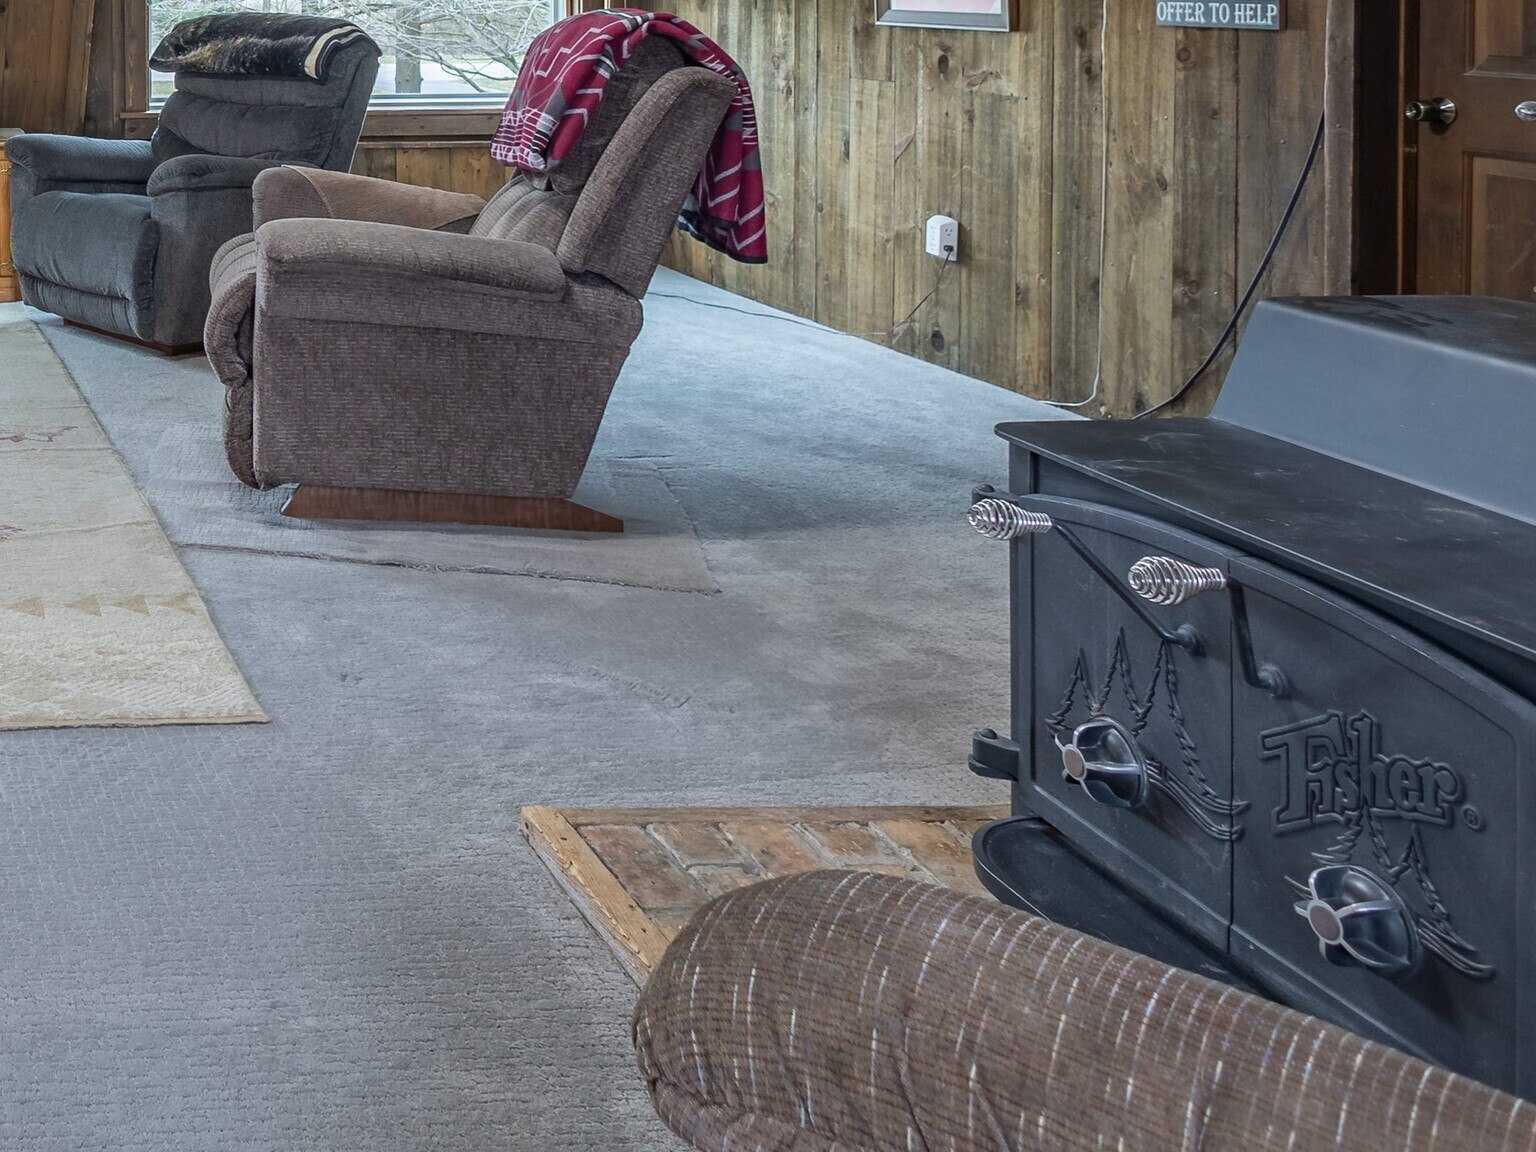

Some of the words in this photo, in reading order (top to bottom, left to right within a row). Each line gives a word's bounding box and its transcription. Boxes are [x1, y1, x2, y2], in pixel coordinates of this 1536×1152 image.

[1156, 1, 1205, 23] OFFER
[1209, 2, 1230, 23] TO
[1234, 3, 1277, 25] HELP
[1261, 709, 1460, 831] Fisher
